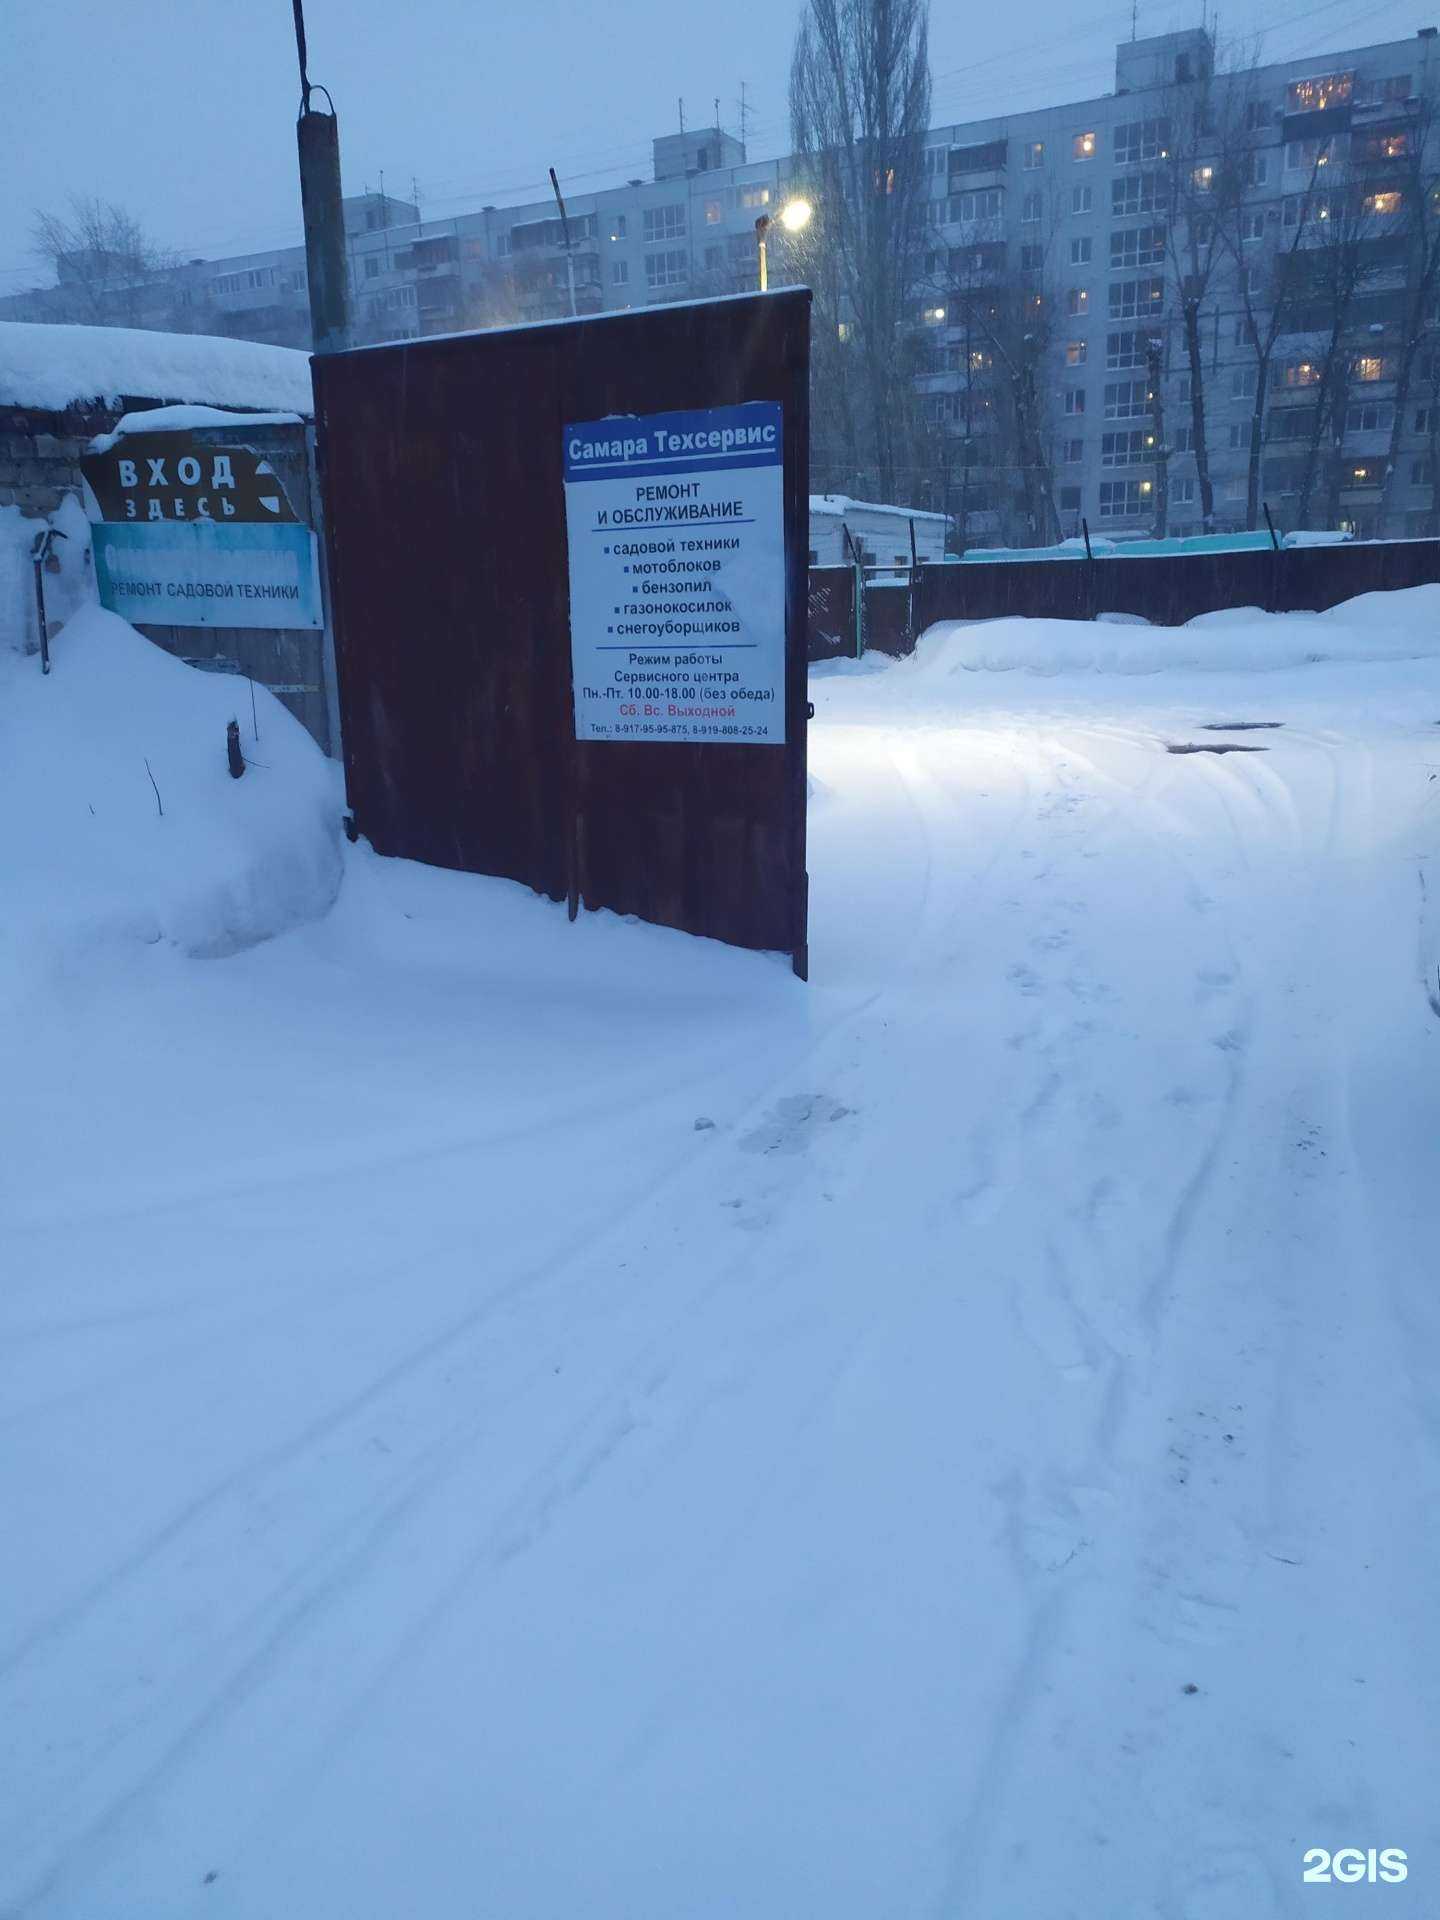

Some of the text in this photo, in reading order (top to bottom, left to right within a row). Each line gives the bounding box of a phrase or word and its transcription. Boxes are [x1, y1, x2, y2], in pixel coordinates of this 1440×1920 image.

[569, 424, 776, 461] Самара Техсервис
[118, 455, 236, 490] ВХОД
[636, 482, 700, 502] РЕМОНТ
[126, 497, 236, 520] ЗДЕСЬ
[597, 501, 744, 525] И ОБСЛУЖИВАНИЕ
[613, 537, 740, 556] садовой техники
[632, 559, 722, 575] мотоблоков
[111, 582, 162, 597] РЕМОНТ
[236, 584, 300, 600] ТЕХНИКИ
[641, 581, 712, 594] бензопил
[623, 601, 733, 615] газонокосилок
[616, 620, 741, 637] снегоуборщиков
[629, 653, 723, 667] Режим работы
[614, 670, 740, 684] Сервисного центра
[628, 687, 696, 700] 10.00-18.00
[699, 687, 727, 701] (без
[730, 687, 775, 702] обеда)
[667, 704, 737, 718] Выходной
